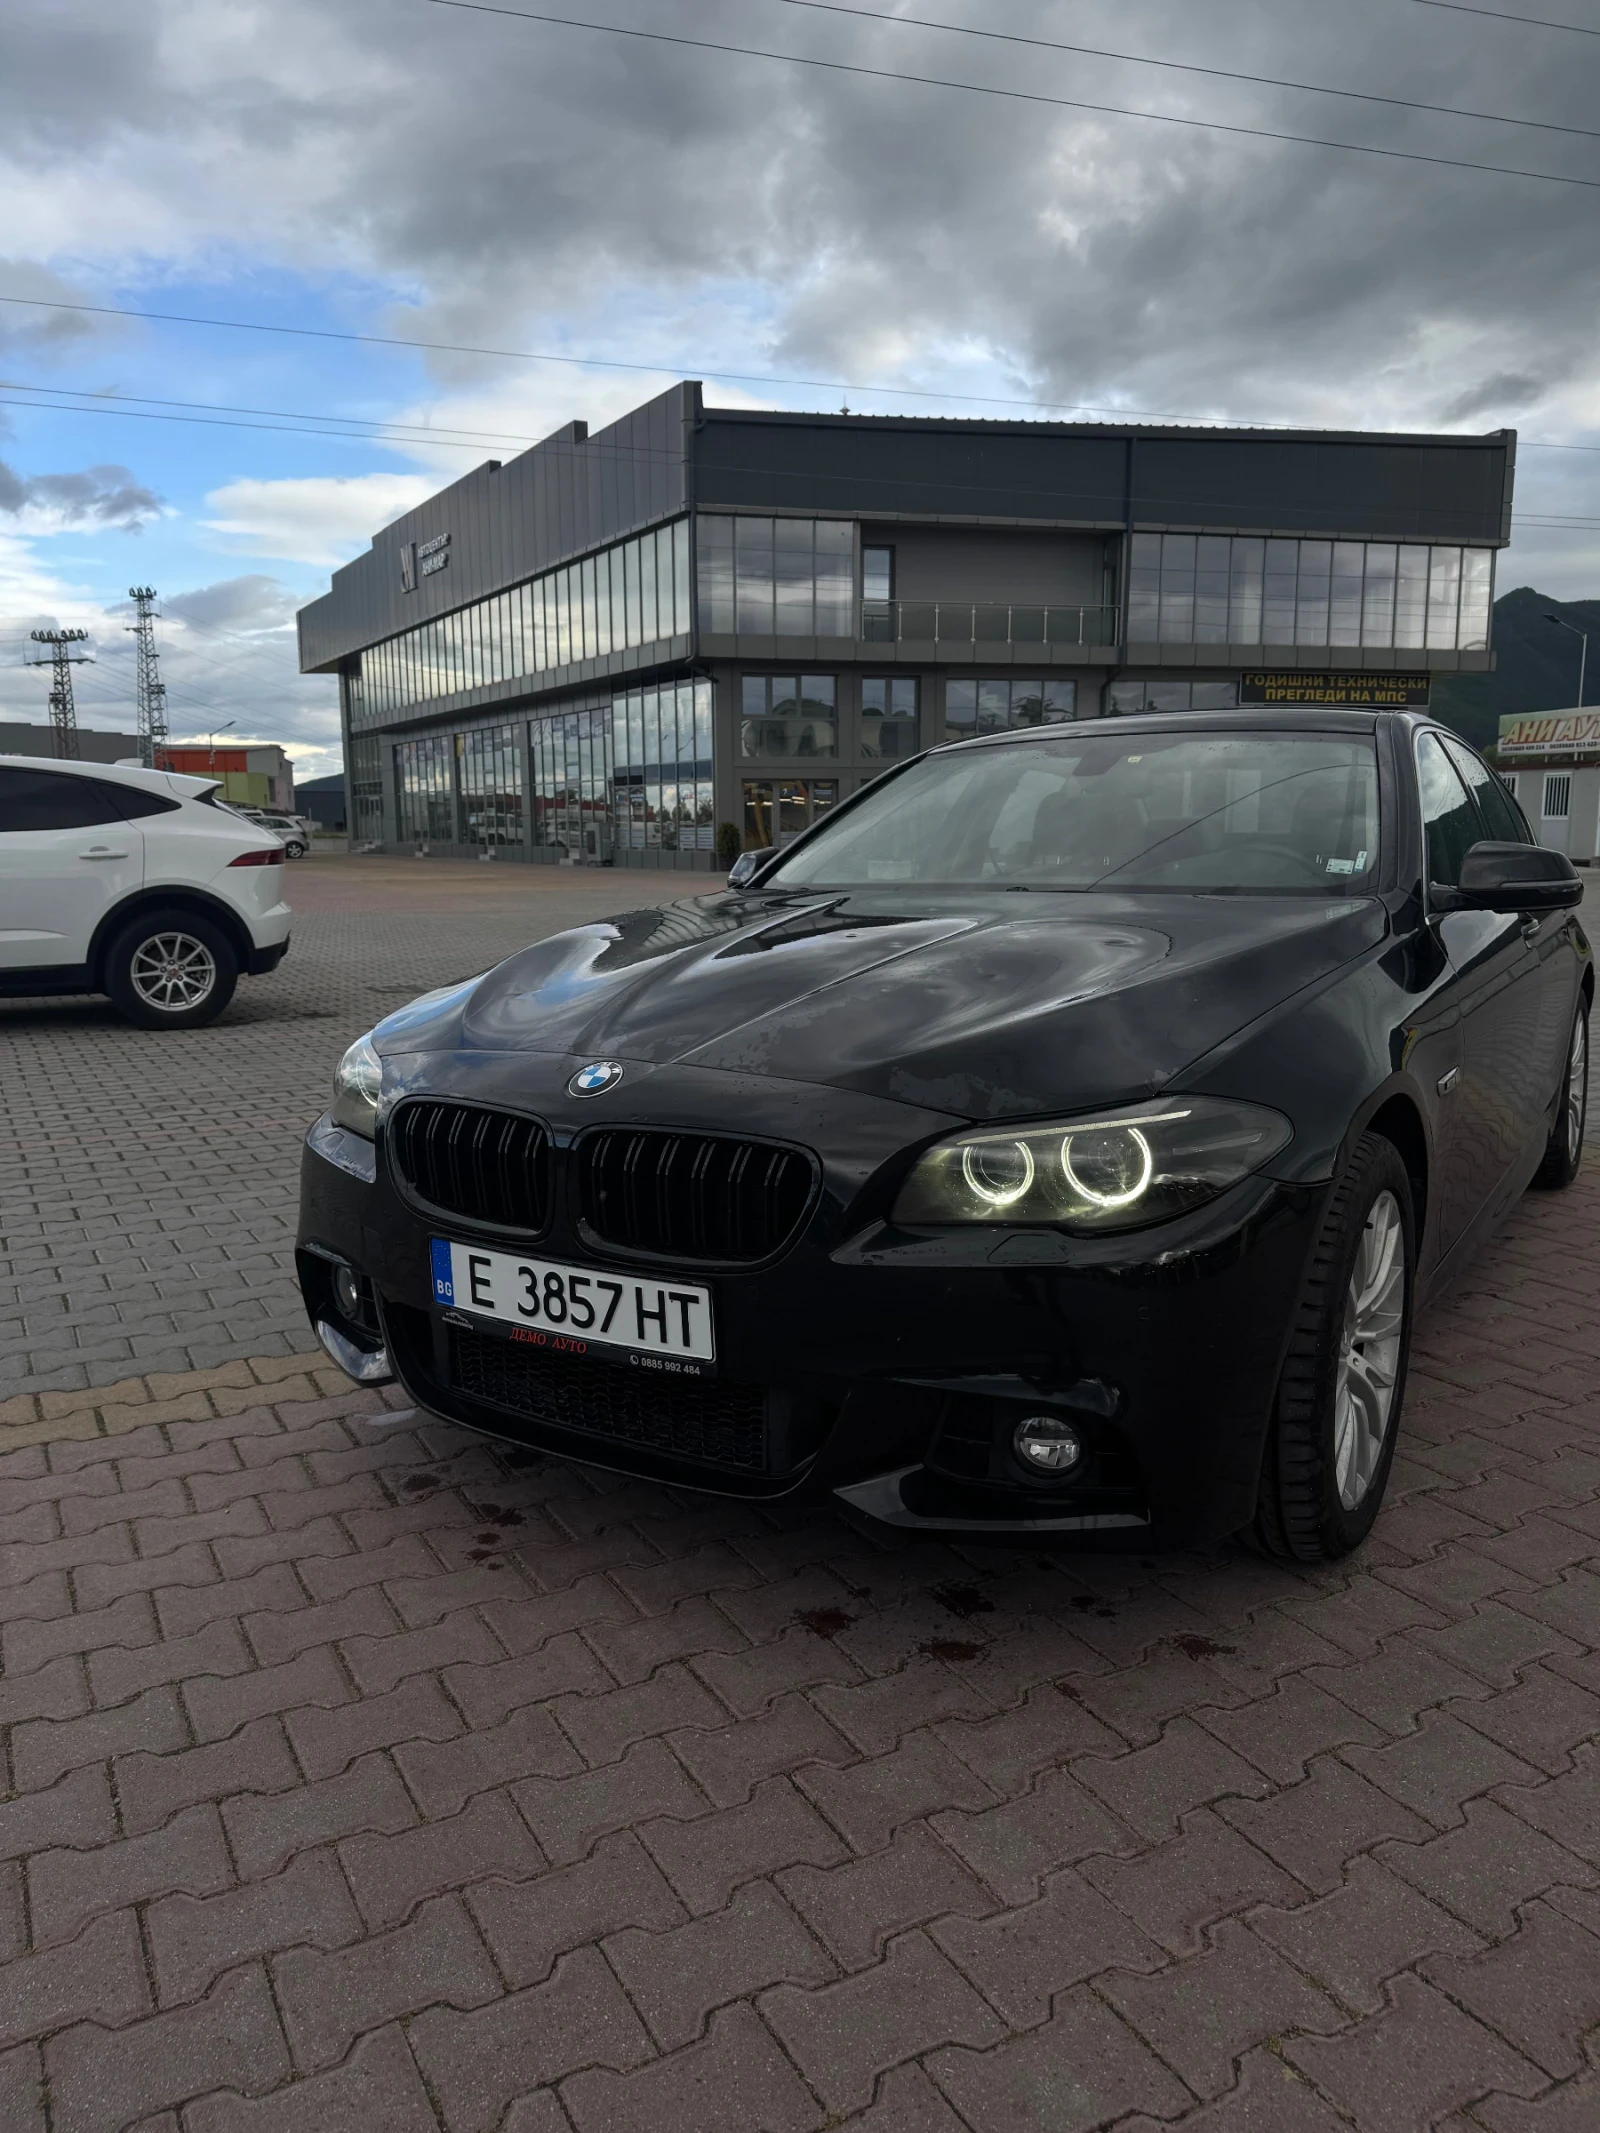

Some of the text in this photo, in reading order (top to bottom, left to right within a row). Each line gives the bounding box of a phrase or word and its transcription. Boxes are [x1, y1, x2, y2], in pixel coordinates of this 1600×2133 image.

[1245, 674, 1427, 689] ГОДИШНИ ТЕХНИЧЕСКИ
[1265, 689, 1407, 703] ПРЕГЛЕДИ НА МПС
[1502, 719, 1561, 745] АНИ
[437, 1279, 452, 1297] BG
[469, 1254, 700, 1348] E 3857 HT
[509, 1328, 587, 1354] ДЕМО АУТО
[641, 1357, 701, 1375] 0885 992 484
